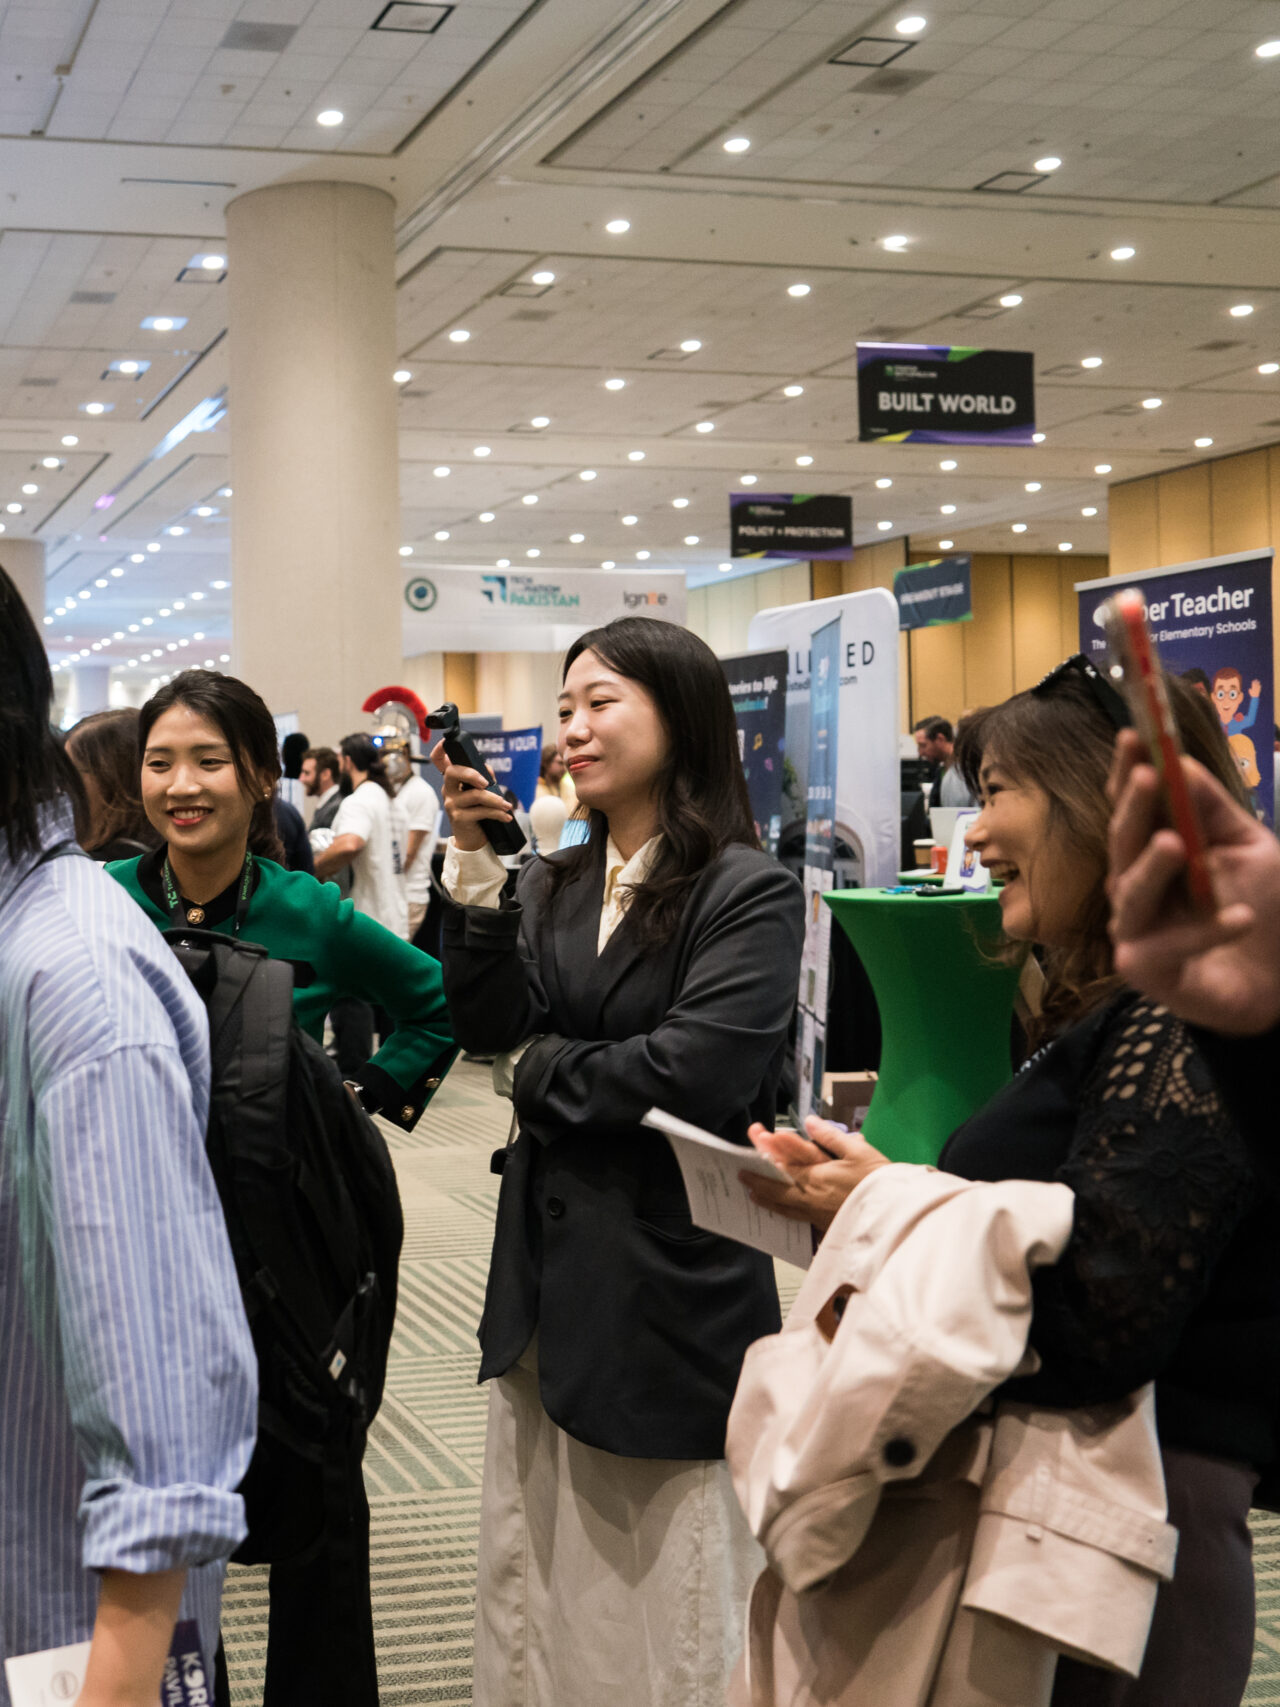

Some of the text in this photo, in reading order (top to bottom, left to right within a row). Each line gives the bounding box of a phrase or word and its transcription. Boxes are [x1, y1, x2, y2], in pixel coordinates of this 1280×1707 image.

[878, 391, 1017, 415] BUILT WORLD
[738, 525, 775, 537] POLICY
[784, 526, 845, 538] PROTECTION
[510, 593, 580, 606] PAKISTAN
[1171, 585, 1255, 618] Teacher
[1091, 639, 1107, 650] The
[1159, 624, 1215, 642] Elementary
[1215, 618, 1257, 635] Schools
[509, 735, 538, 752] YOUR
[167, 891, 179, 909] TC
[180, 1651, 211, 1707] KOR
